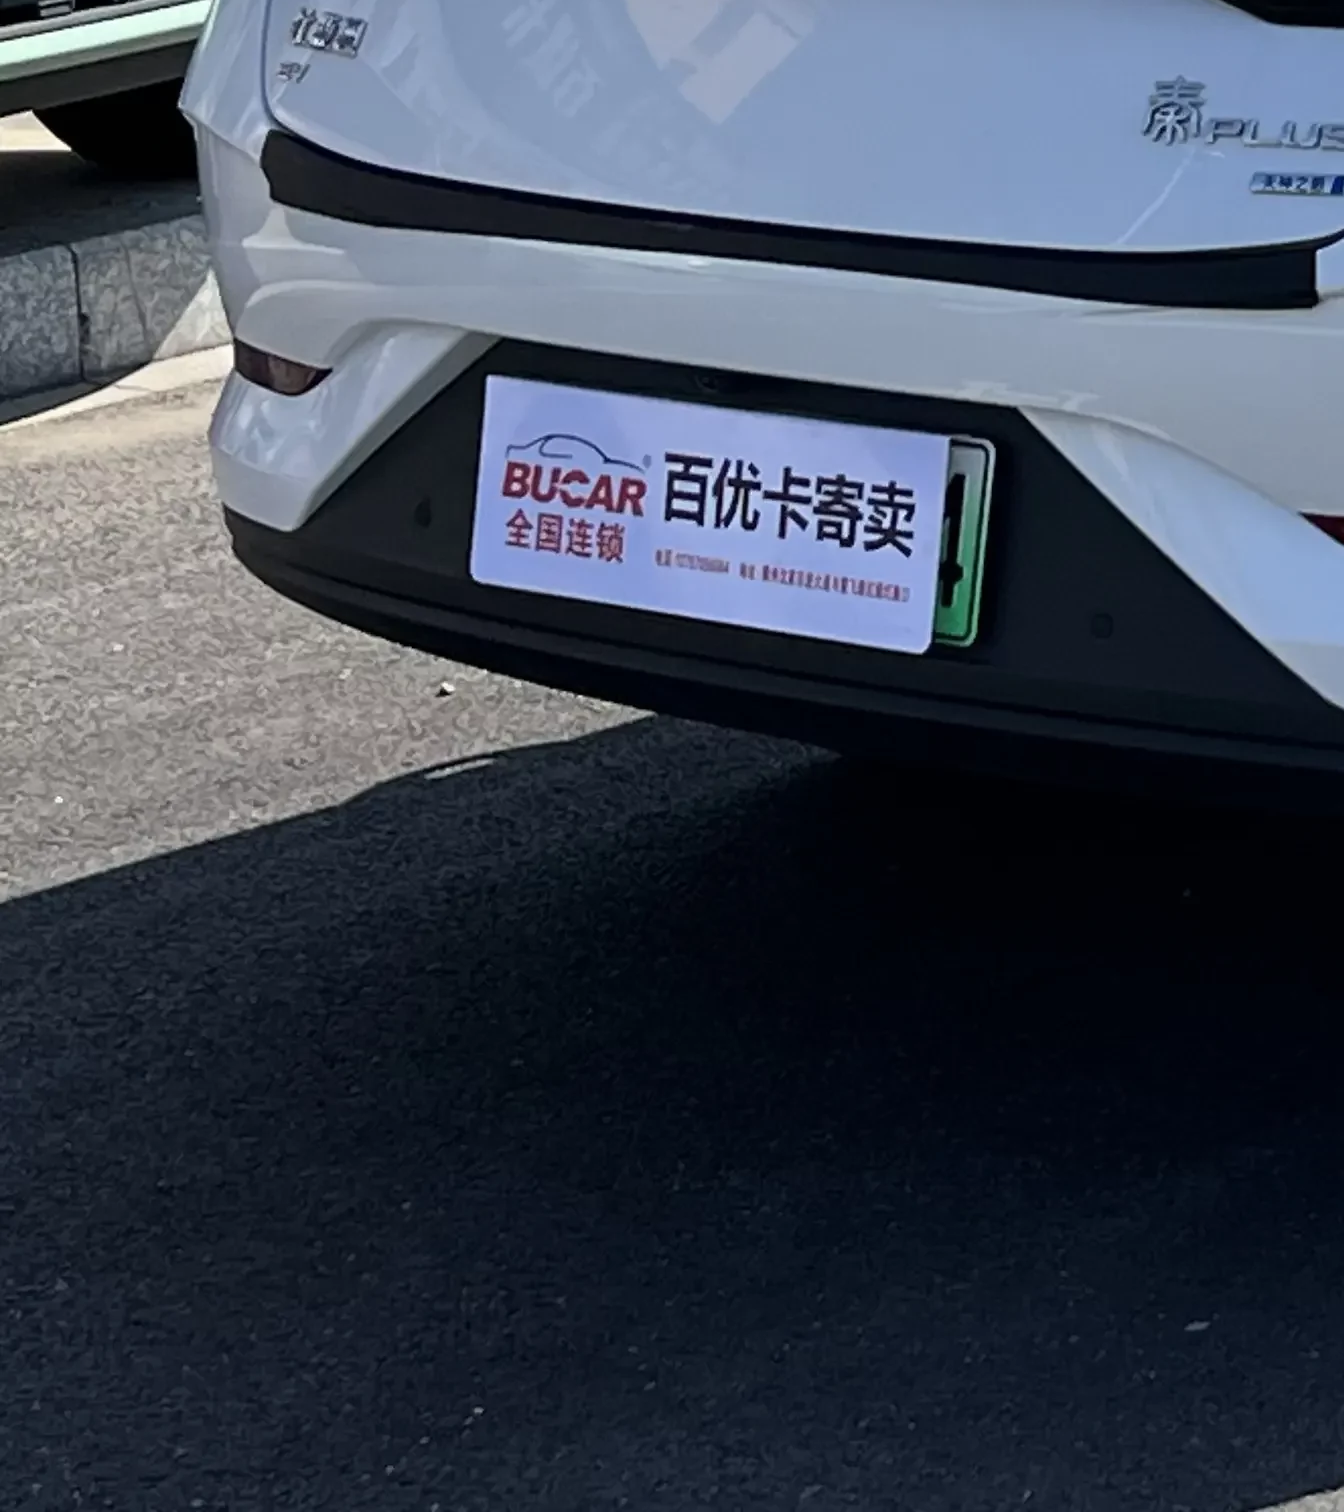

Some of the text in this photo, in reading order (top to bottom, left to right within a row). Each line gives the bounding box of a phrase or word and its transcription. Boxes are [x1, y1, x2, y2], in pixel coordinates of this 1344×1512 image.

[502, 461, 647, 517] BUCAR
[663, 452, 915, 558] 百优卡寄卖
[505, 509, 625, 563] 全国连锁
